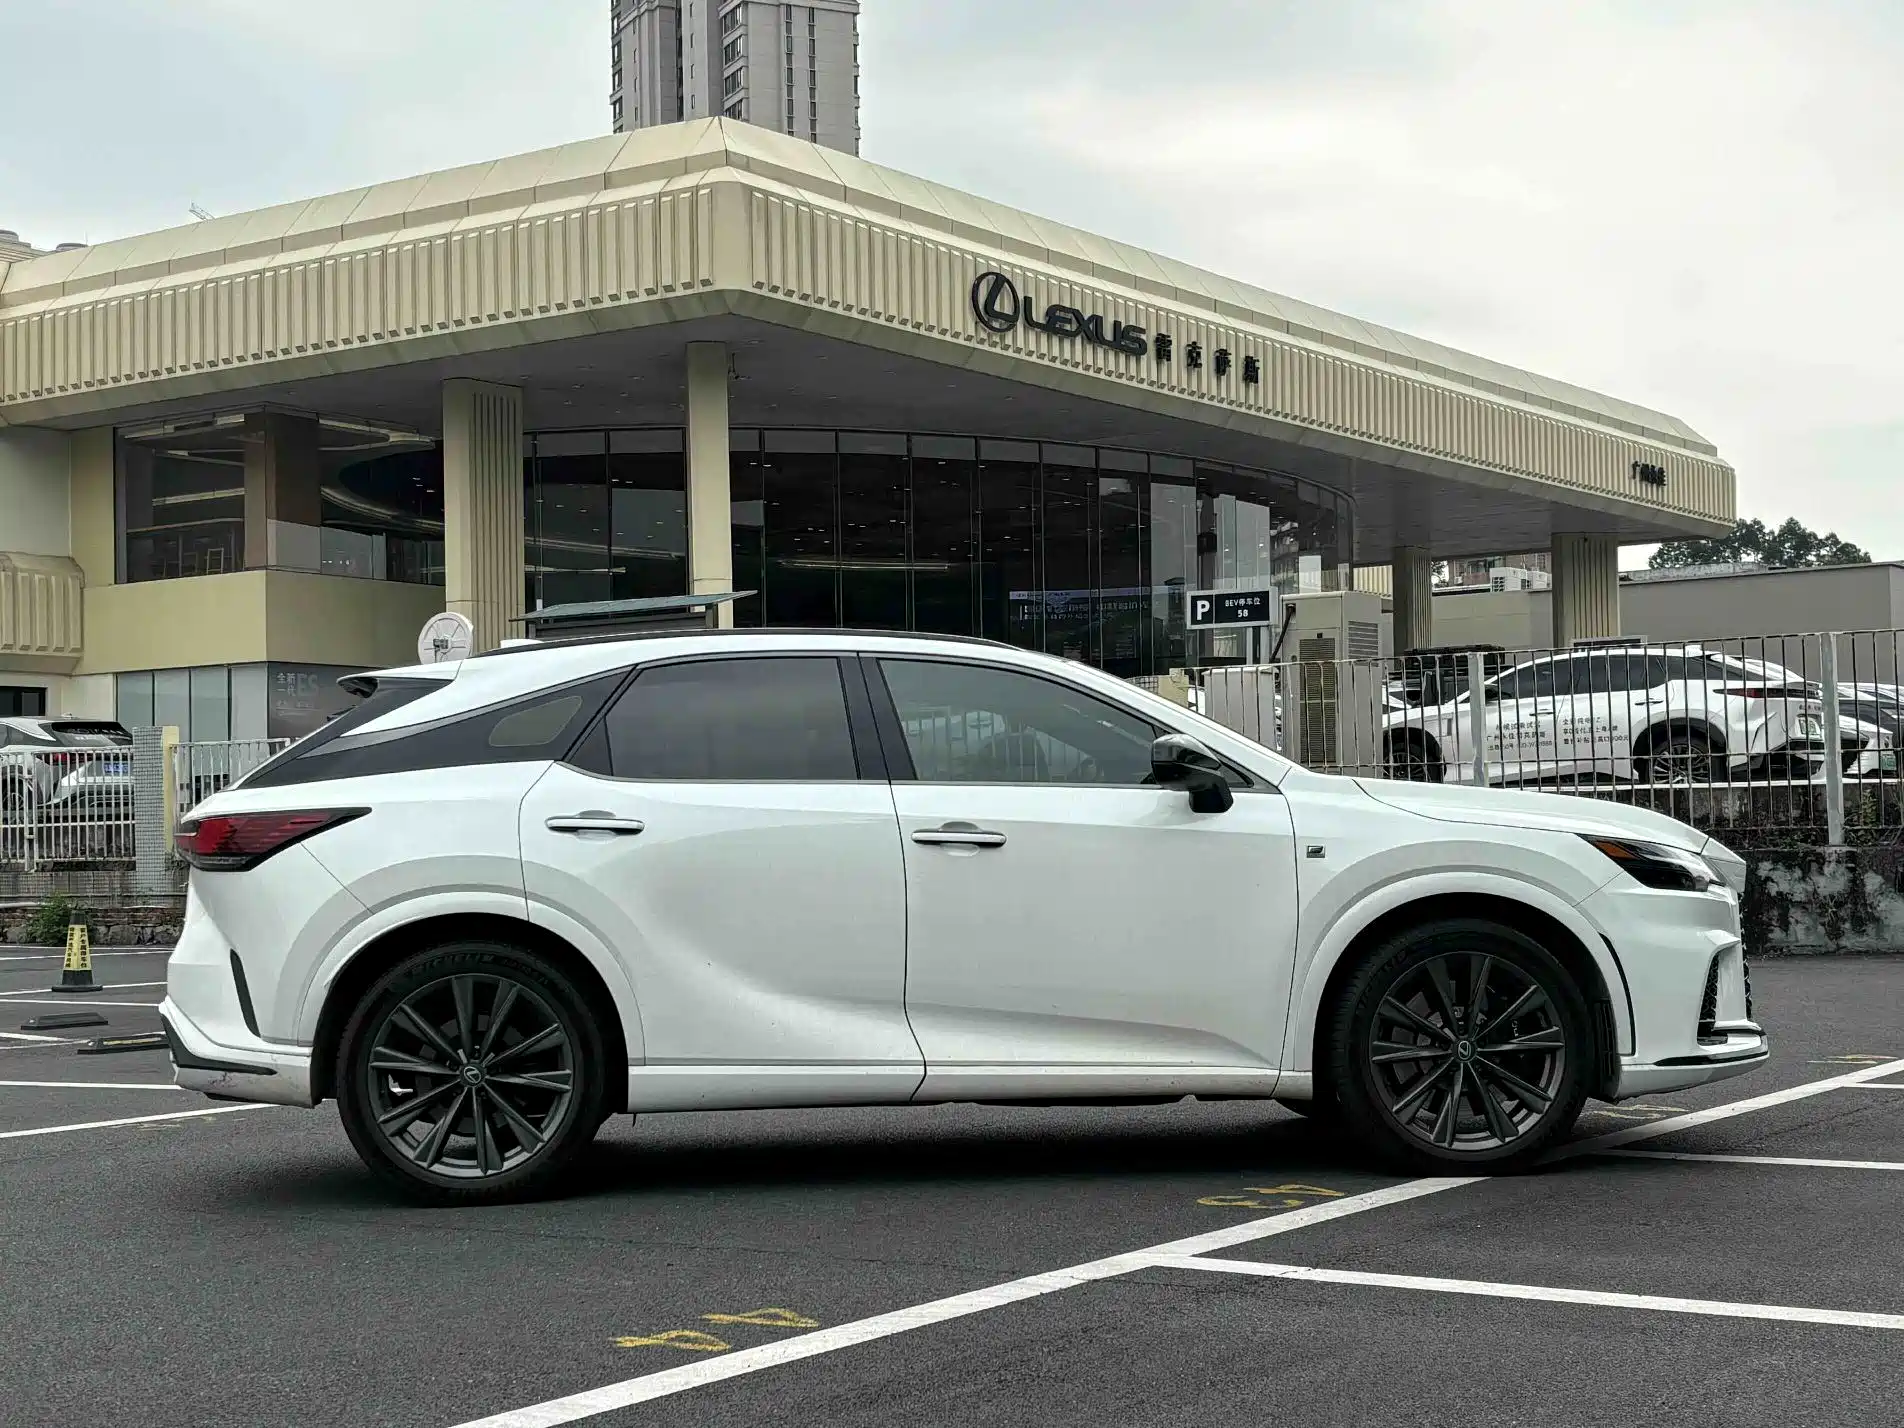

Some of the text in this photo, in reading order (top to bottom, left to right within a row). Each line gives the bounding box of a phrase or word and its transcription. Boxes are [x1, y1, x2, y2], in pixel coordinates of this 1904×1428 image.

[1023, 296, 1148, 355] LEXUS
[1196, 600, 1211, 621] P
[1237, 609, 1249, 618] 58
